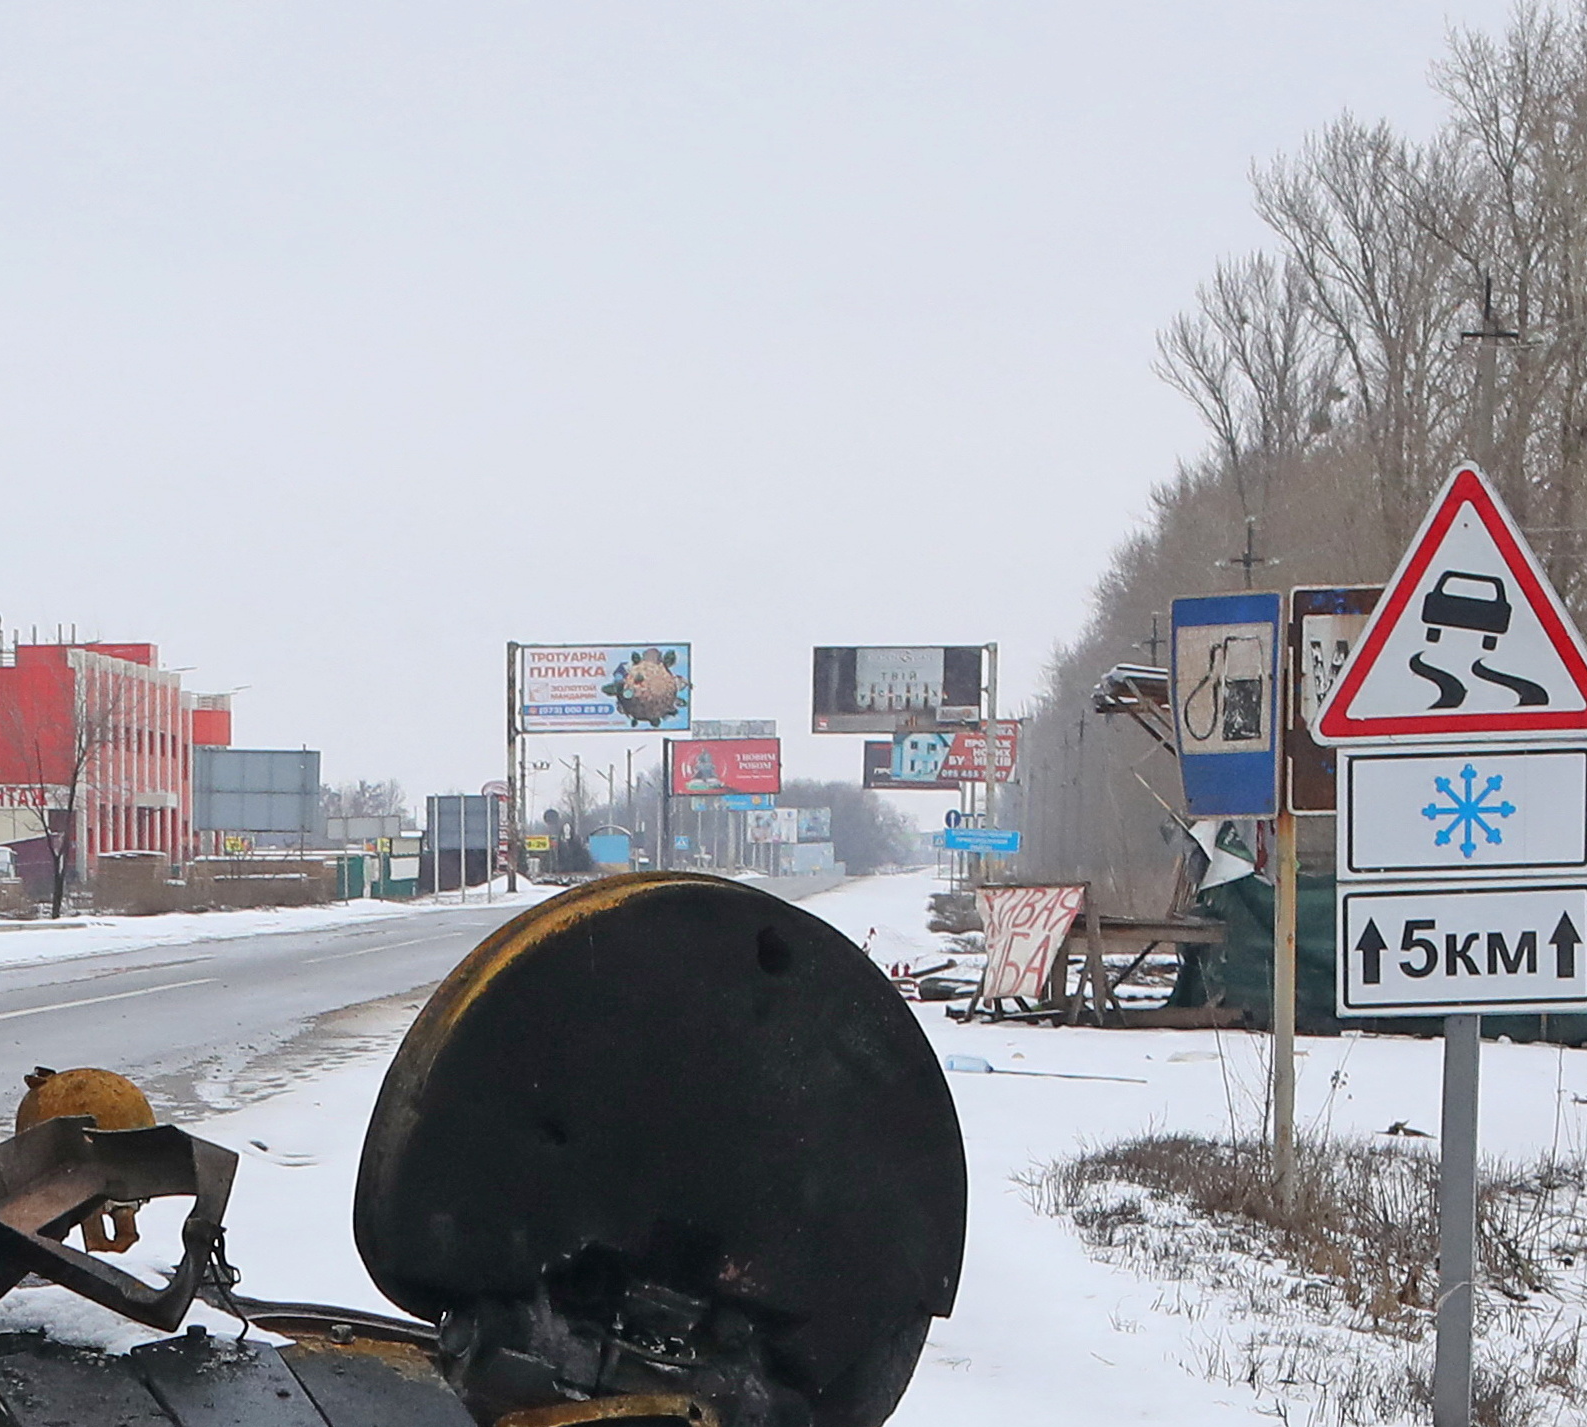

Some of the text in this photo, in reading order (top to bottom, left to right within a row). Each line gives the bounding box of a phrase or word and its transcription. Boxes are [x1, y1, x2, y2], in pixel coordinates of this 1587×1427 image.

[530, 652, 606, 662] ТРОТУАРНА
[530, 666, 606, 678] ПЛИТКА
[1399, 918, 1537, 978] 5км
